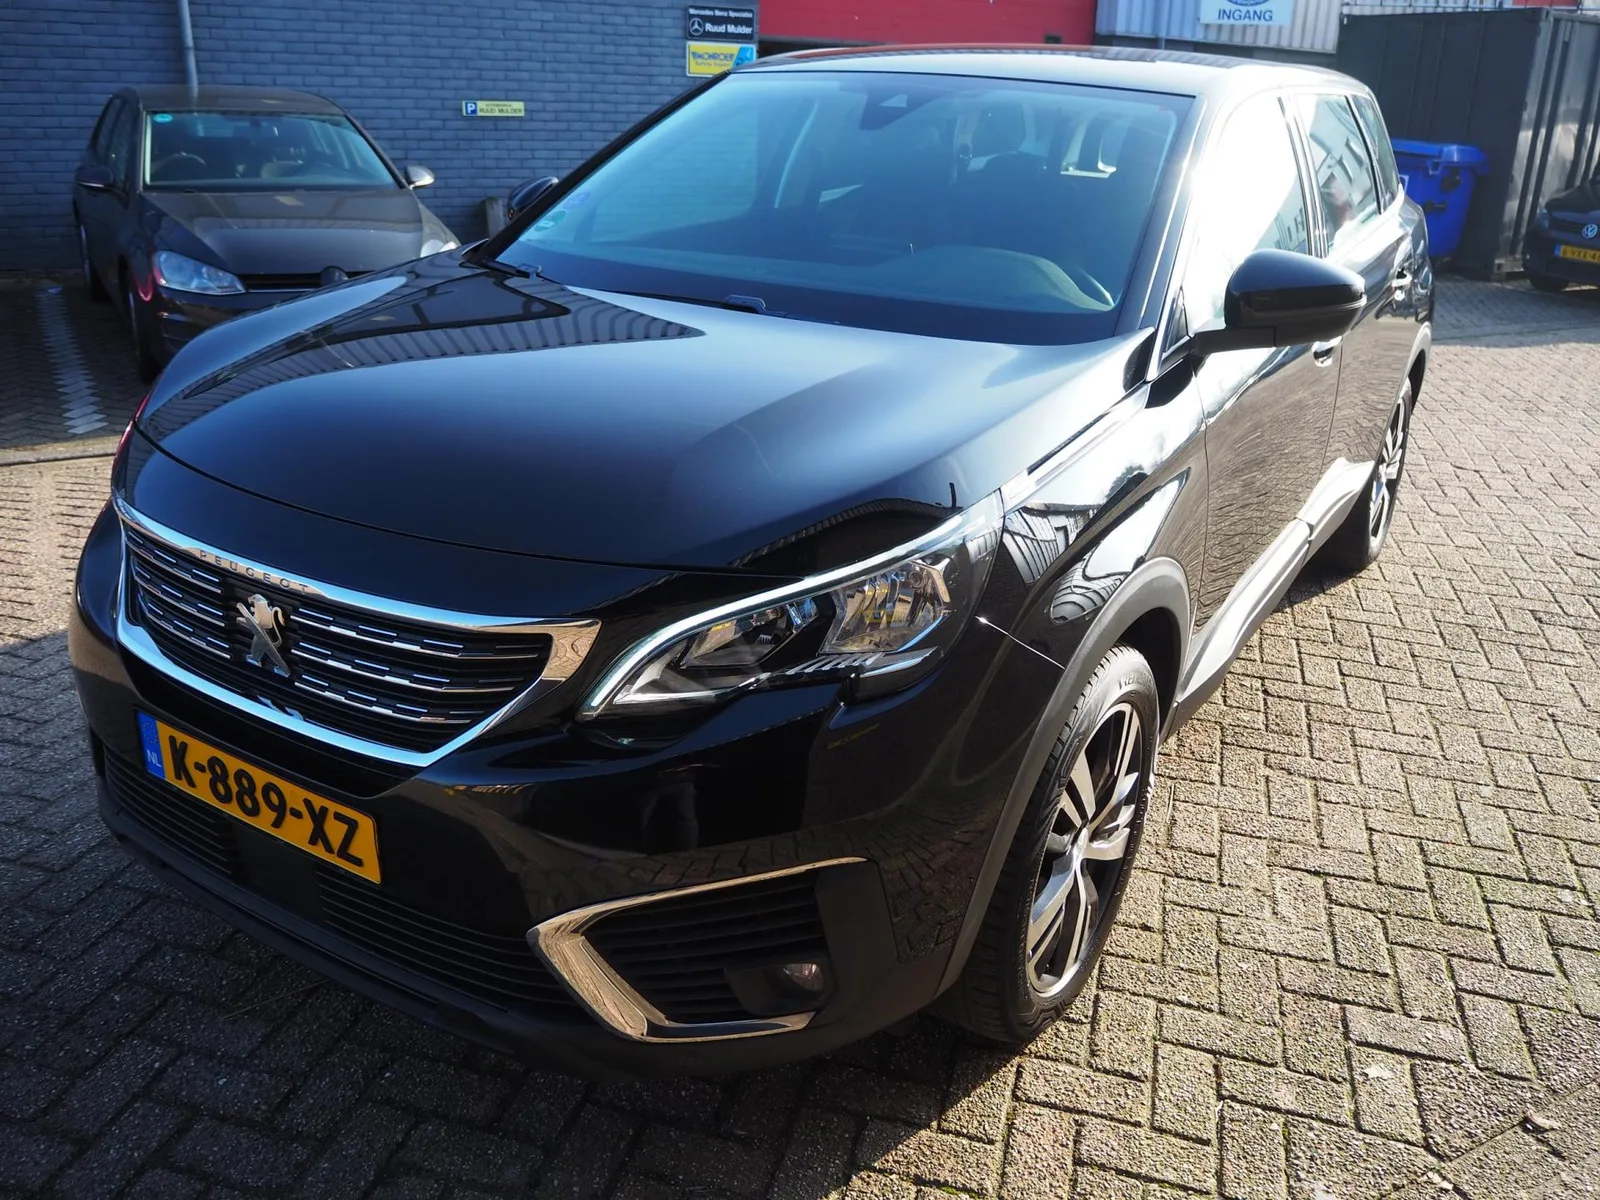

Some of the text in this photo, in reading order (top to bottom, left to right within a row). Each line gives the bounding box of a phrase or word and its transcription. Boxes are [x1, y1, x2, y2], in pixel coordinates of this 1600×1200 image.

[1218, 8, 1273, 22] INGANG
[705, 23, 753, 35] Ruud Mulder
[694, 51, 732, 62] MONROE
[466, 103, 476, 114] P
[199, 549, 308, 595] PEUGEOT
[147, 749, 162, 768] NL
[168, 735, 364, 867] K-889-XZ
